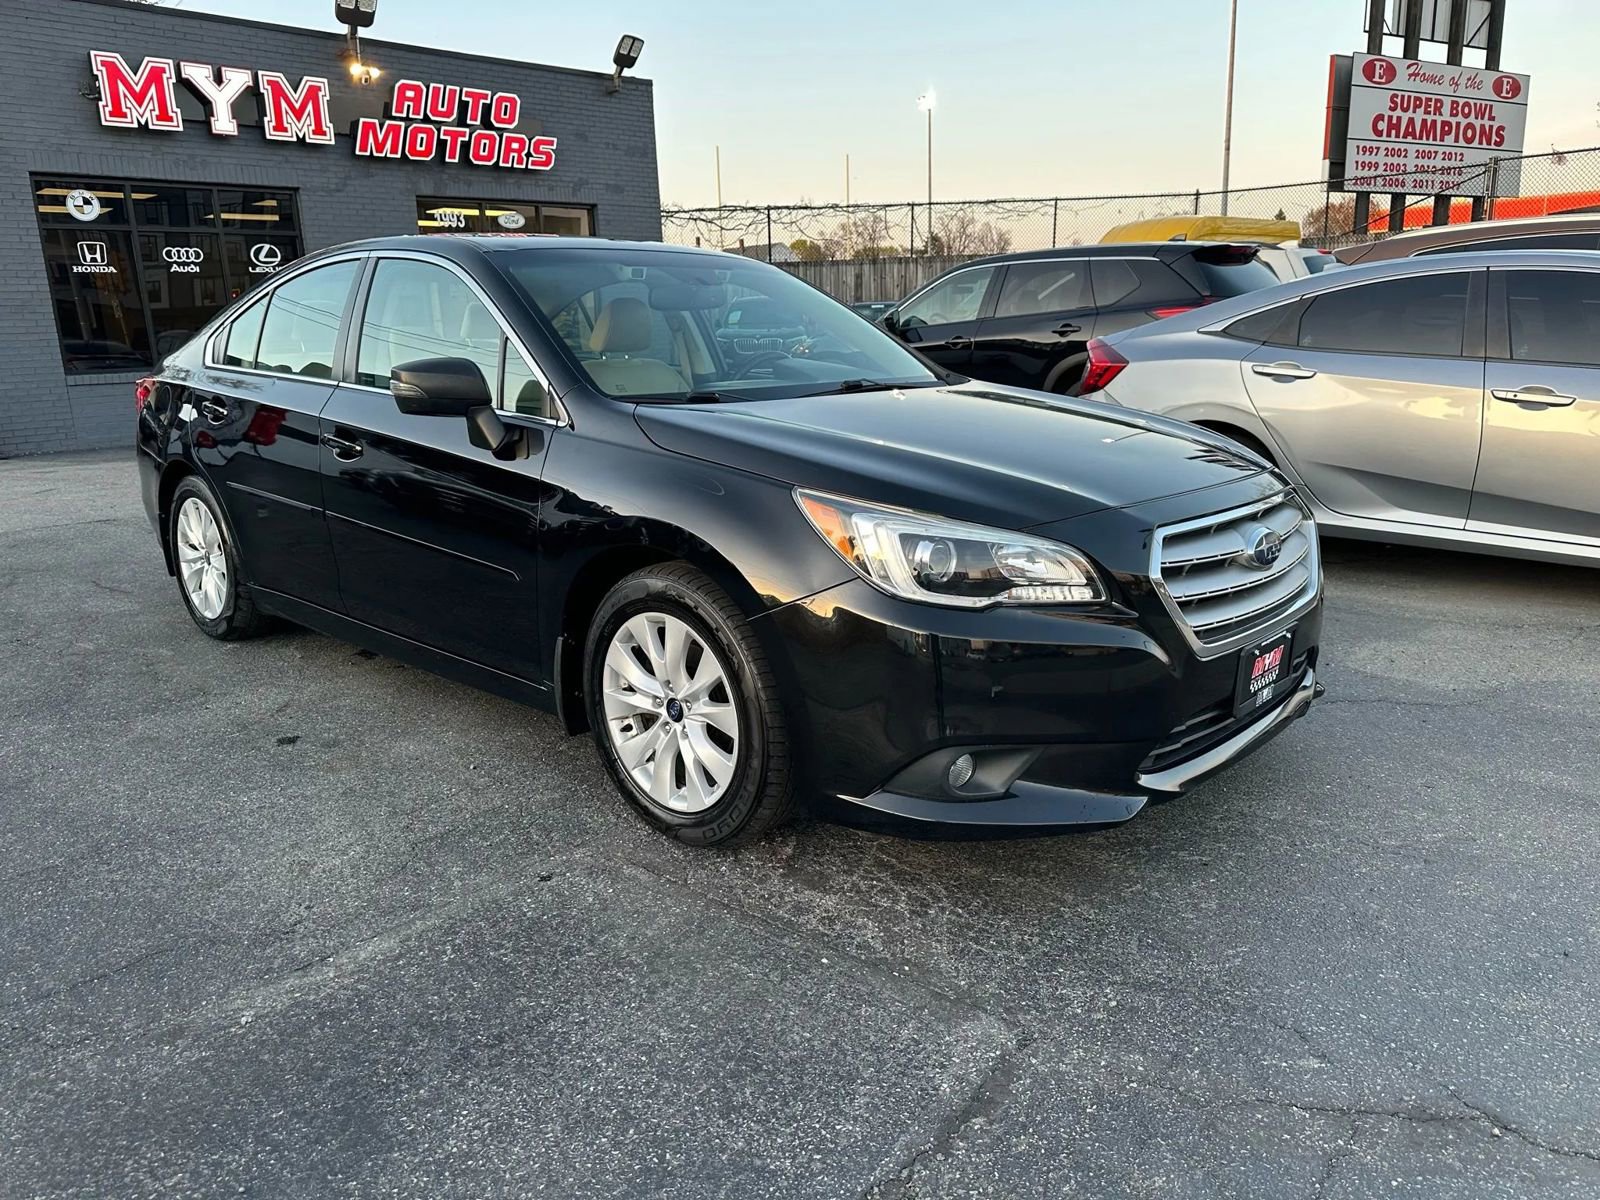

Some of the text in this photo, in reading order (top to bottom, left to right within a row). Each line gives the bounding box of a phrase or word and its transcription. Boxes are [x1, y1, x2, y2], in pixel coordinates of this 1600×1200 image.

[1373, 61, 1387, 83] E
[1406, 62, 1483, 93] Home of the
[89, 50, 335, 145] MYM
[1501, 78, 1513, 98] E
[391, 79, 521, 130] AUTO
[1388, 93, 1496, 122] SUPER BOWL
[1371, 113, 1506, 148] CHAMPIONS
[355, 117, 558, 171] MOTORS
[1355, 145, 1464, 162] 1997 2002 2007 2012
[1354, 161, 1379, 171] 1999
[1383, 163, 1407, 173] 2003
[1381, 177, 1406, 188] 2006
[1411, 179, 1435, 189] 2011
[434, 210, 466, 228] 1993
[503, 214, 521, 226] Ford
[72, 265, 118, 273] HONDA
[170, 263, 200, 272] Audi
